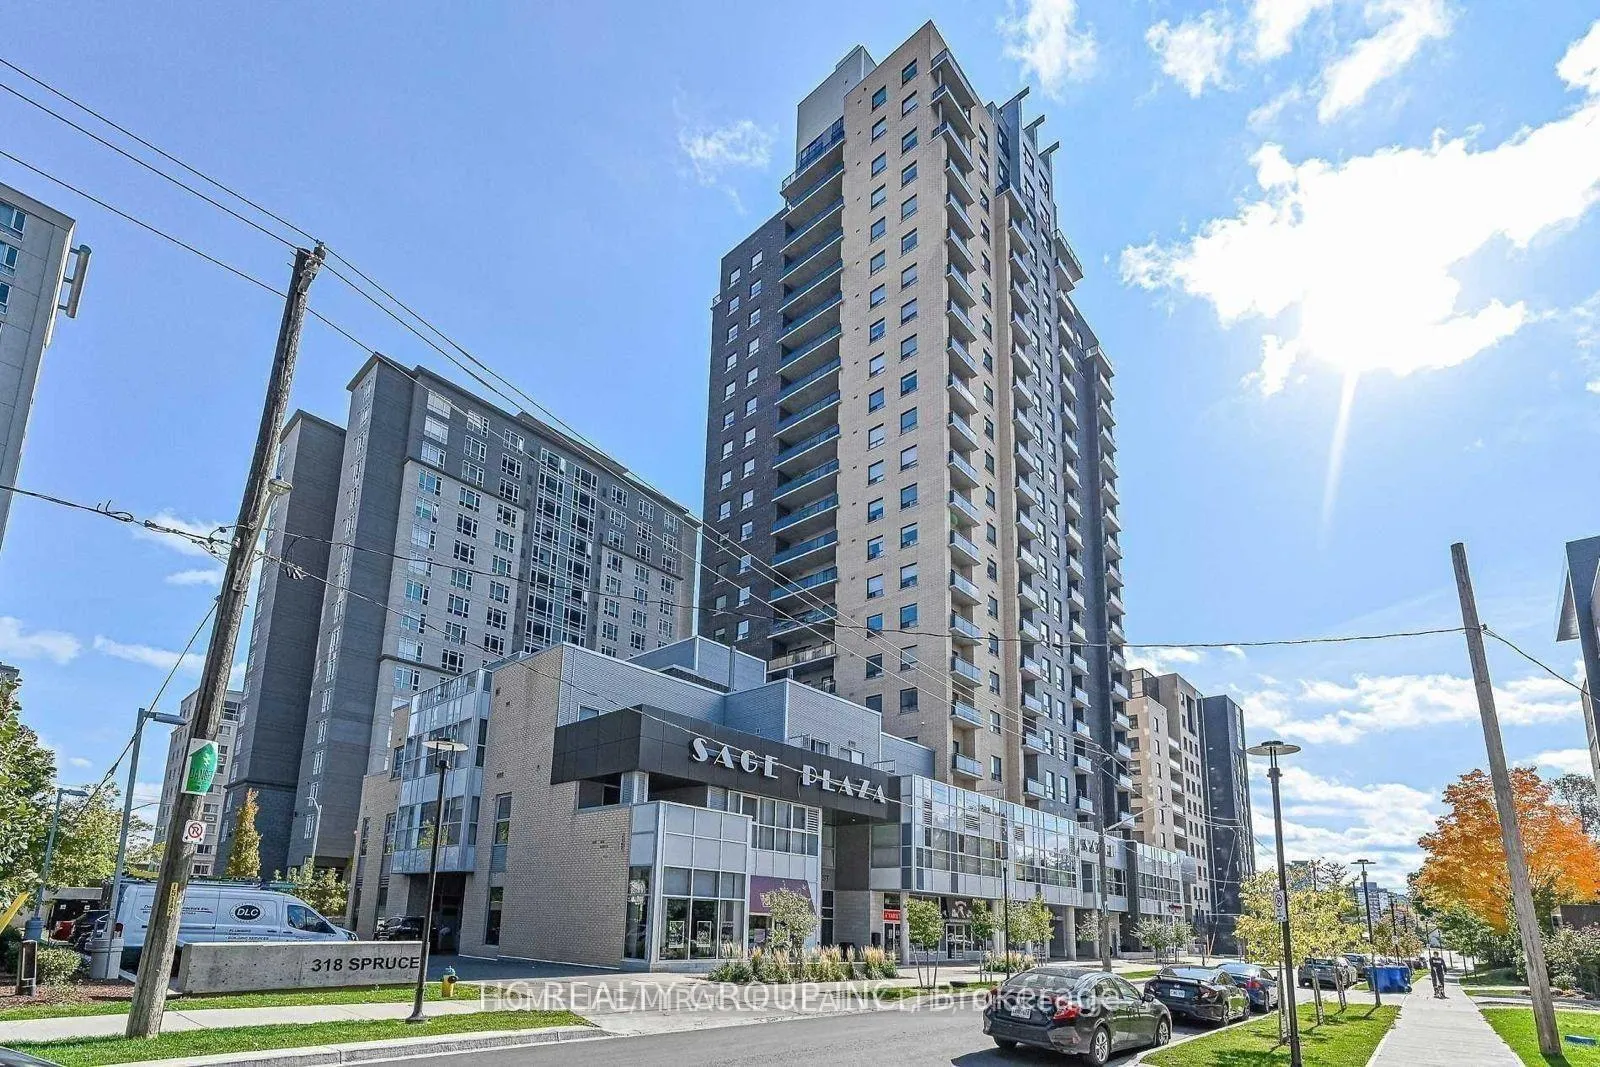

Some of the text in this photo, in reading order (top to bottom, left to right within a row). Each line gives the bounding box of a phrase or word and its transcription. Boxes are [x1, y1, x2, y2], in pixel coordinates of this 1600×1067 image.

[691, 737, 886, 804] SAGE PLAZA
[236, 908, 259, 916] DLC
[311, 956, 420, 972] 318 SPRUCE
